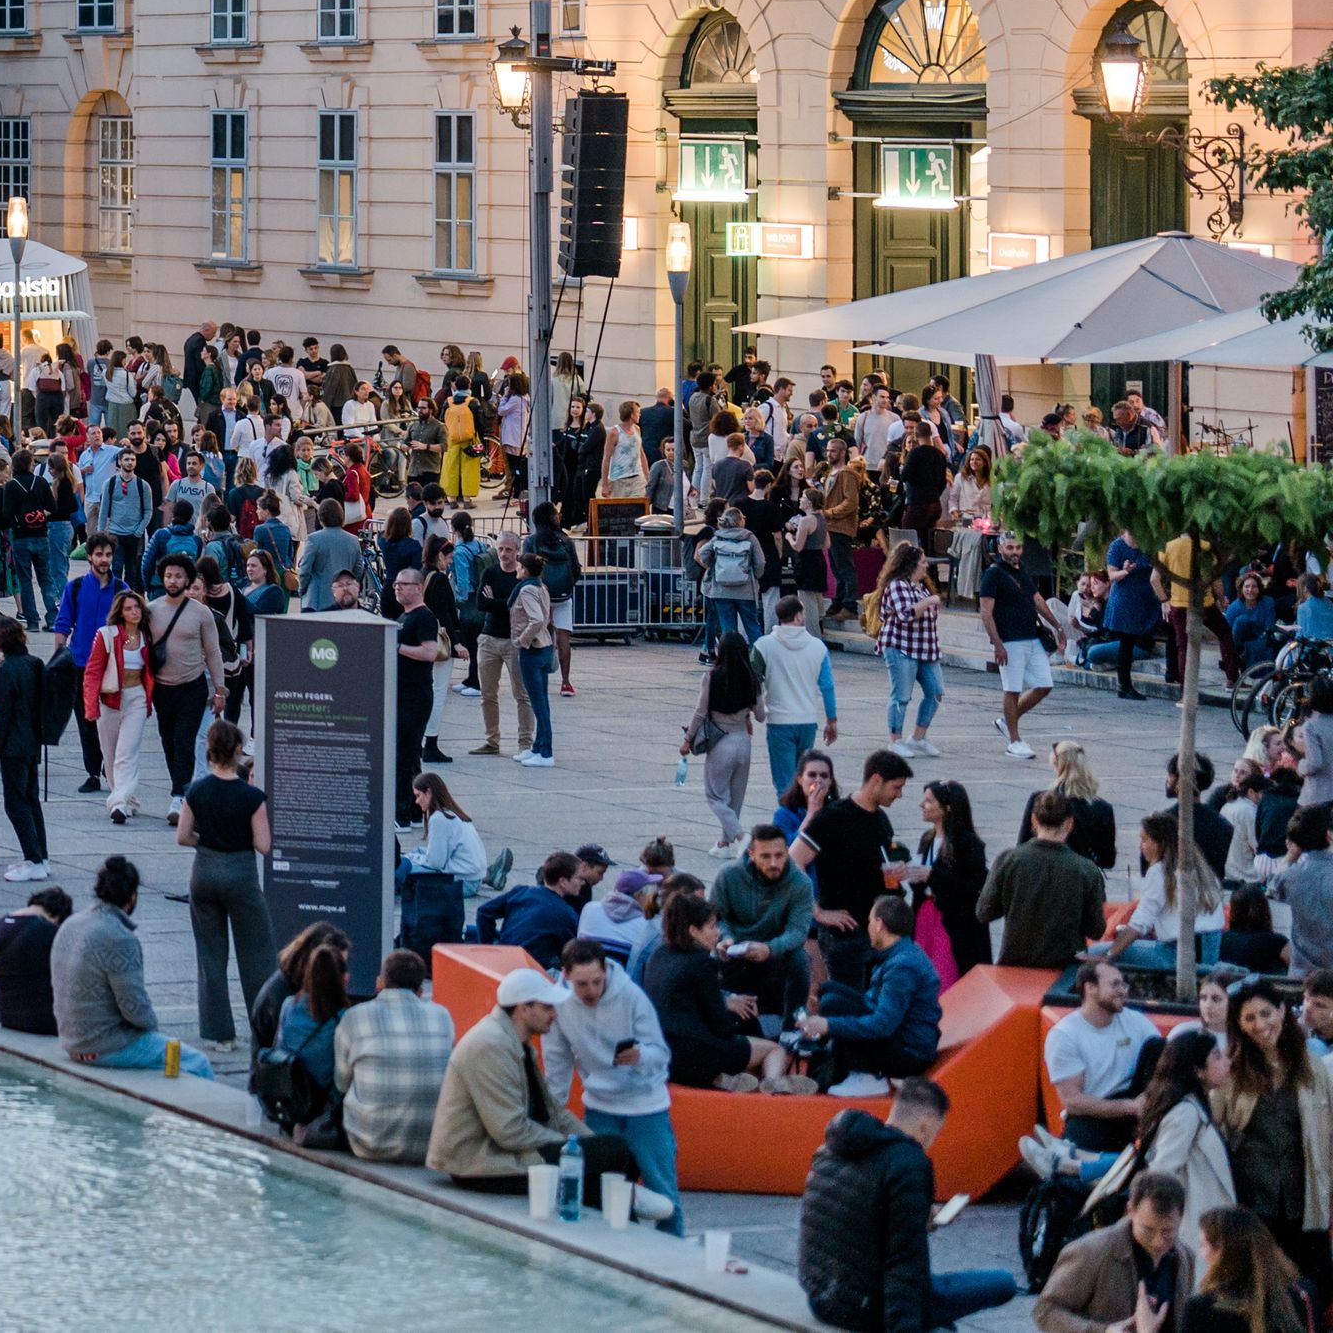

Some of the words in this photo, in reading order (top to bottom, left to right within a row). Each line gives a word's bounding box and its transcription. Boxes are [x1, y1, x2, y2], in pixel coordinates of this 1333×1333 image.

[179, 485, 205, 497] NASA
[311, 647, 338, 661] MQ
[274, 691, 303, 699] JUDITH
[297, 902, 347, 914] www.mqw.at
